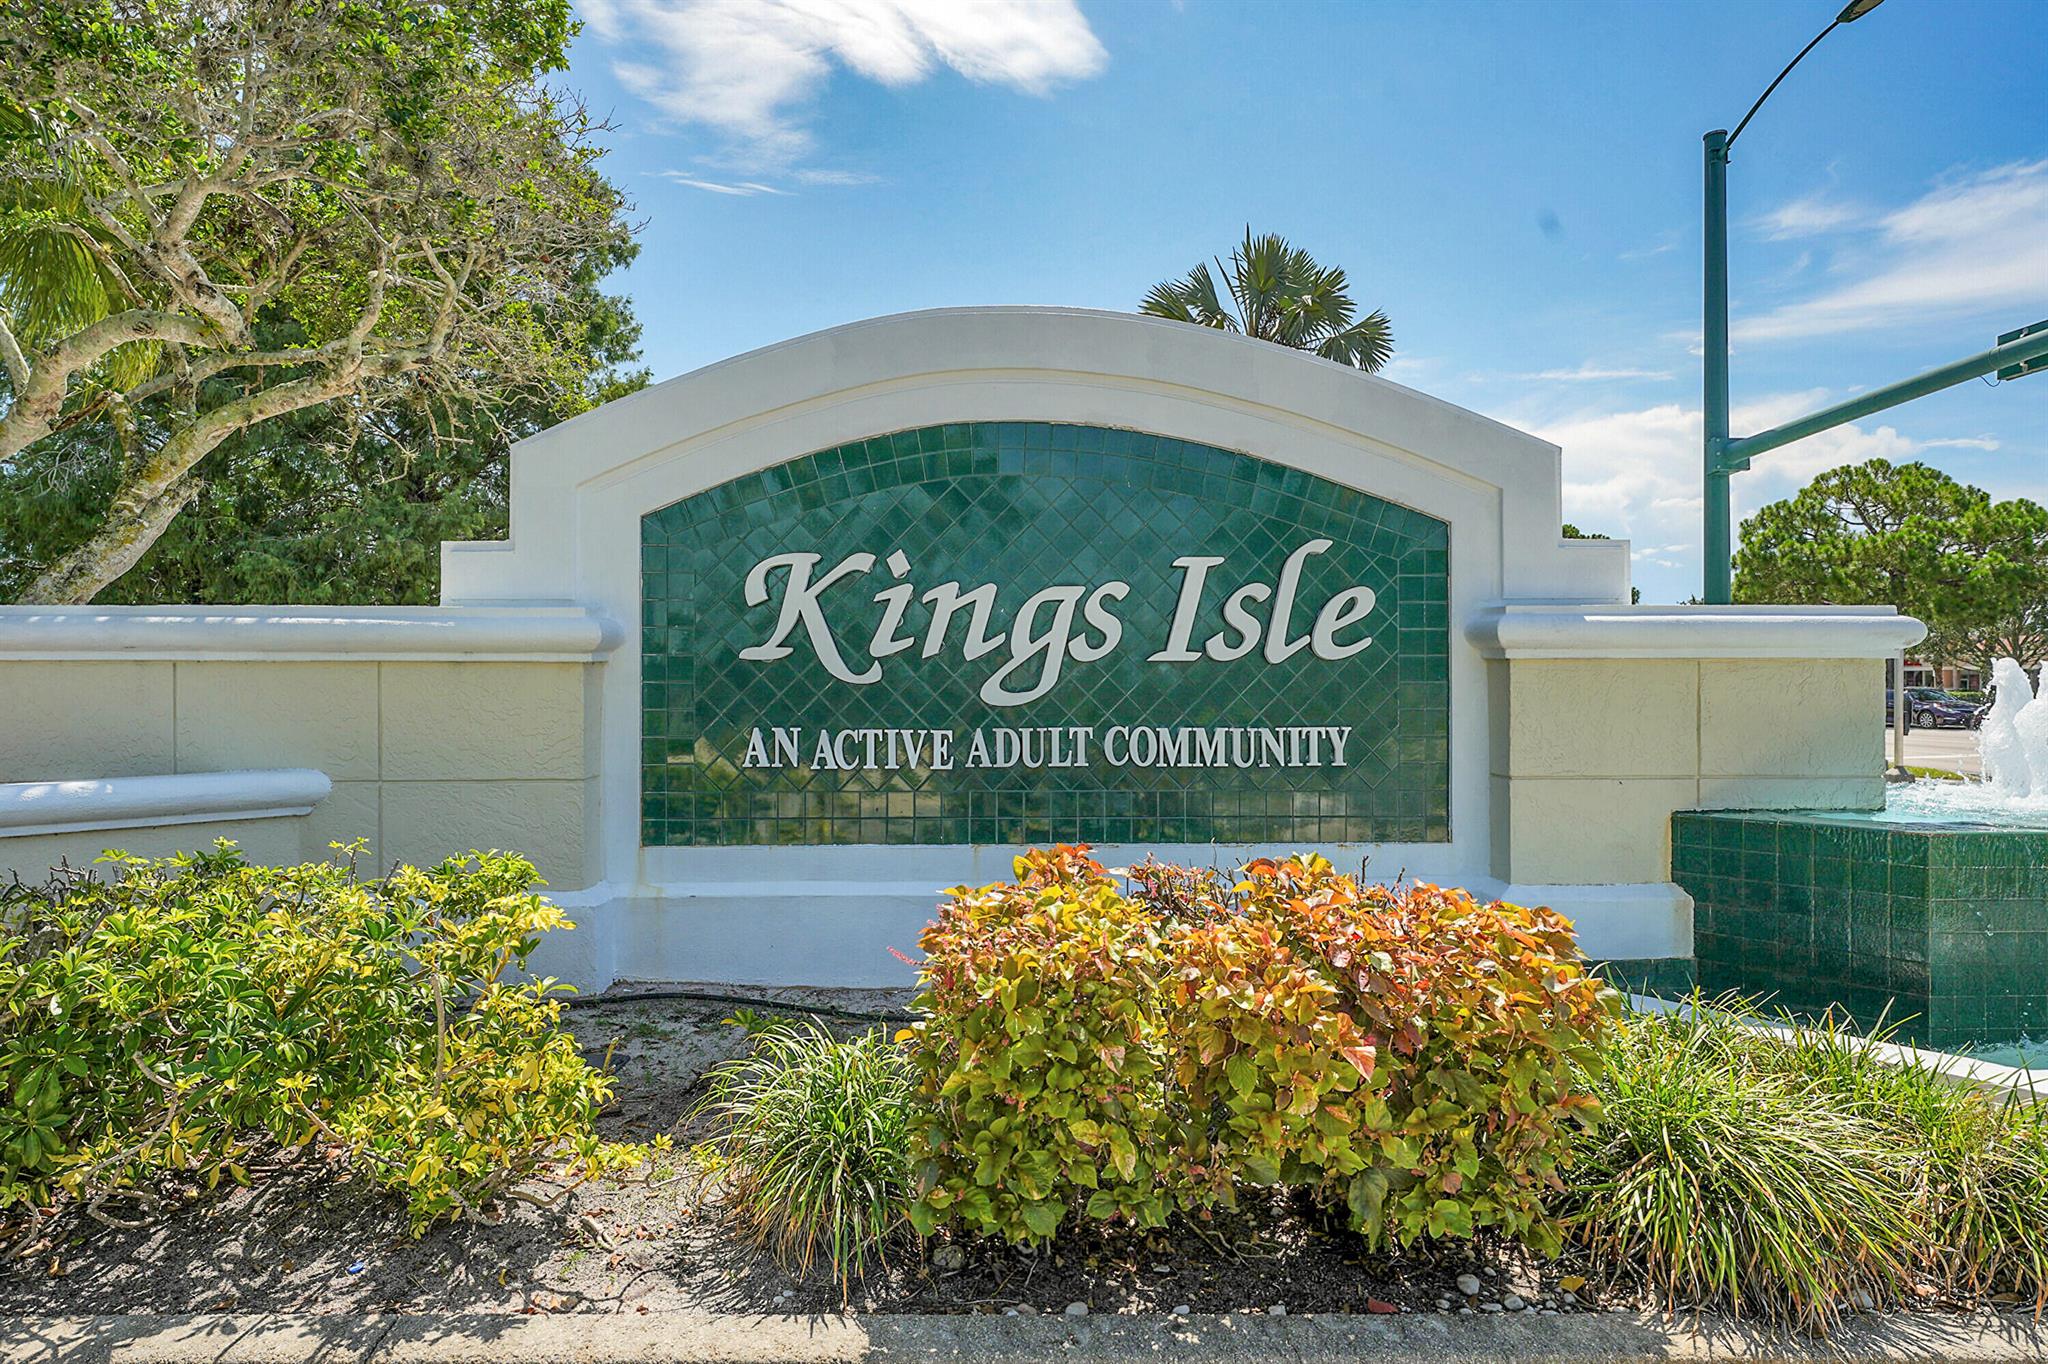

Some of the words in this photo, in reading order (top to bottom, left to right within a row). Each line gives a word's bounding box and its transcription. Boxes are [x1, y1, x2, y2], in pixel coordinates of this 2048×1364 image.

[739, 549, 1130, 707] Kings
[1148, 540, 1375, 664] Isle
[743, 728, 801, 768] AN
[811, 730, 954, 770] ACTIVE
[966, 727, 1093, 768] ADULT
[1105, 726, 1352, 768] COMMUNITY
